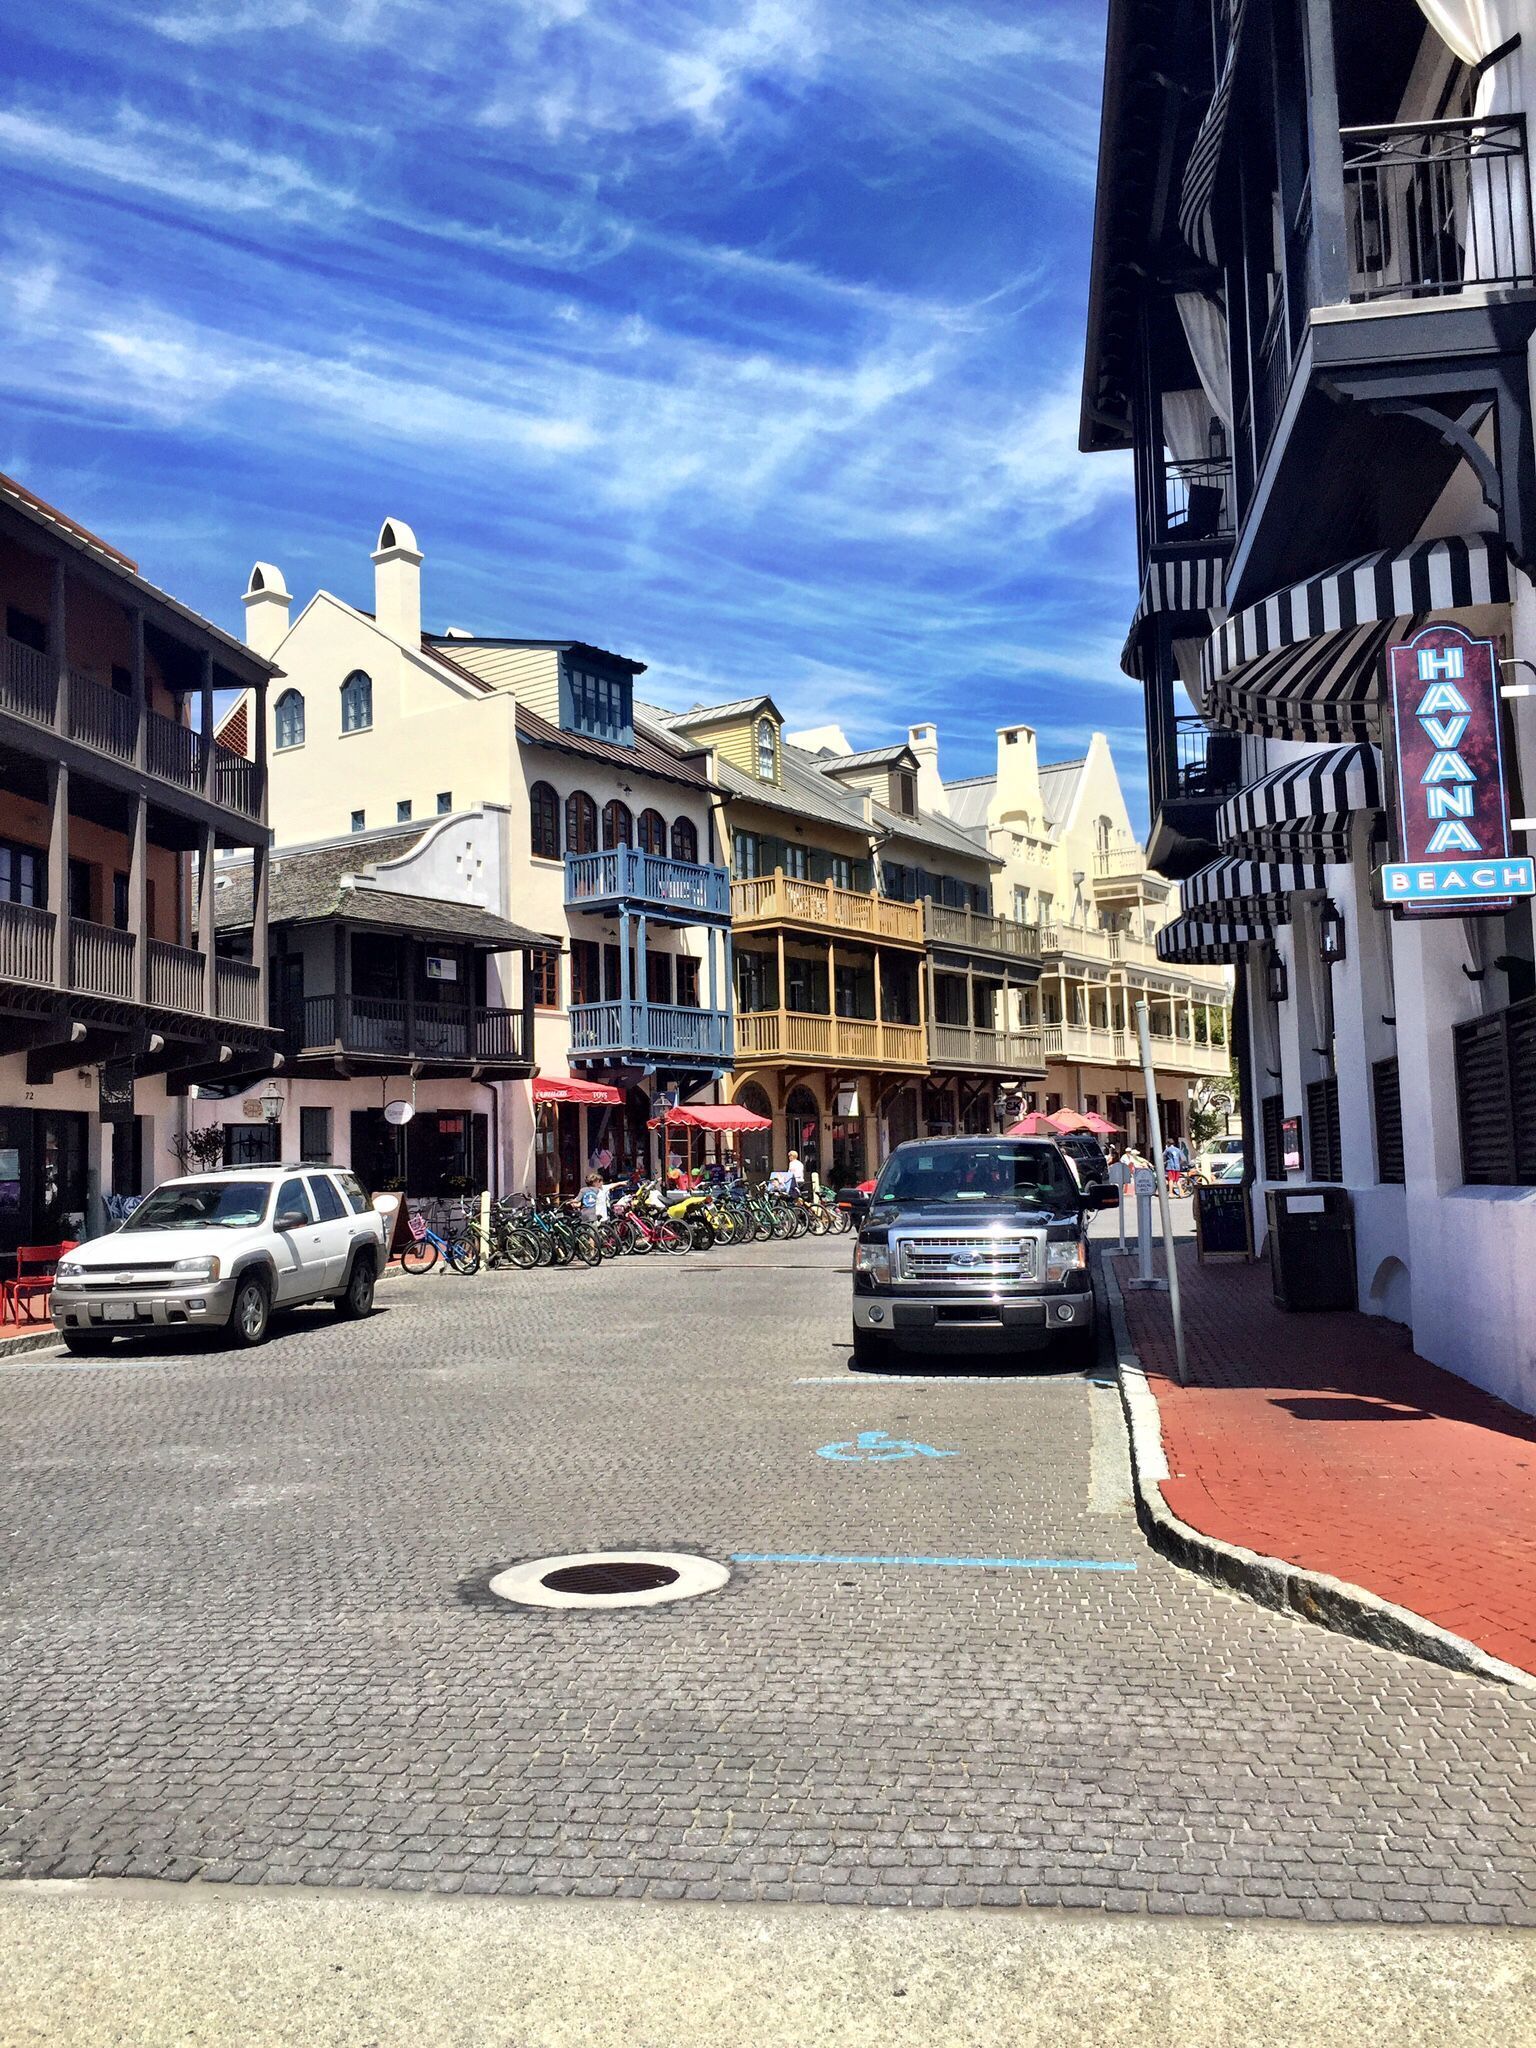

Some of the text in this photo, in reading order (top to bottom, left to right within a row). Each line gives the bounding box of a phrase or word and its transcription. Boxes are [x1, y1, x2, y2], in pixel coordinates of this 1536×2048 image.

[1415, 647, 1482, 854] HAVANA
[1391, 866, 1527, 891] BEACH
[592, 1091, 608, 1100] TOYS
